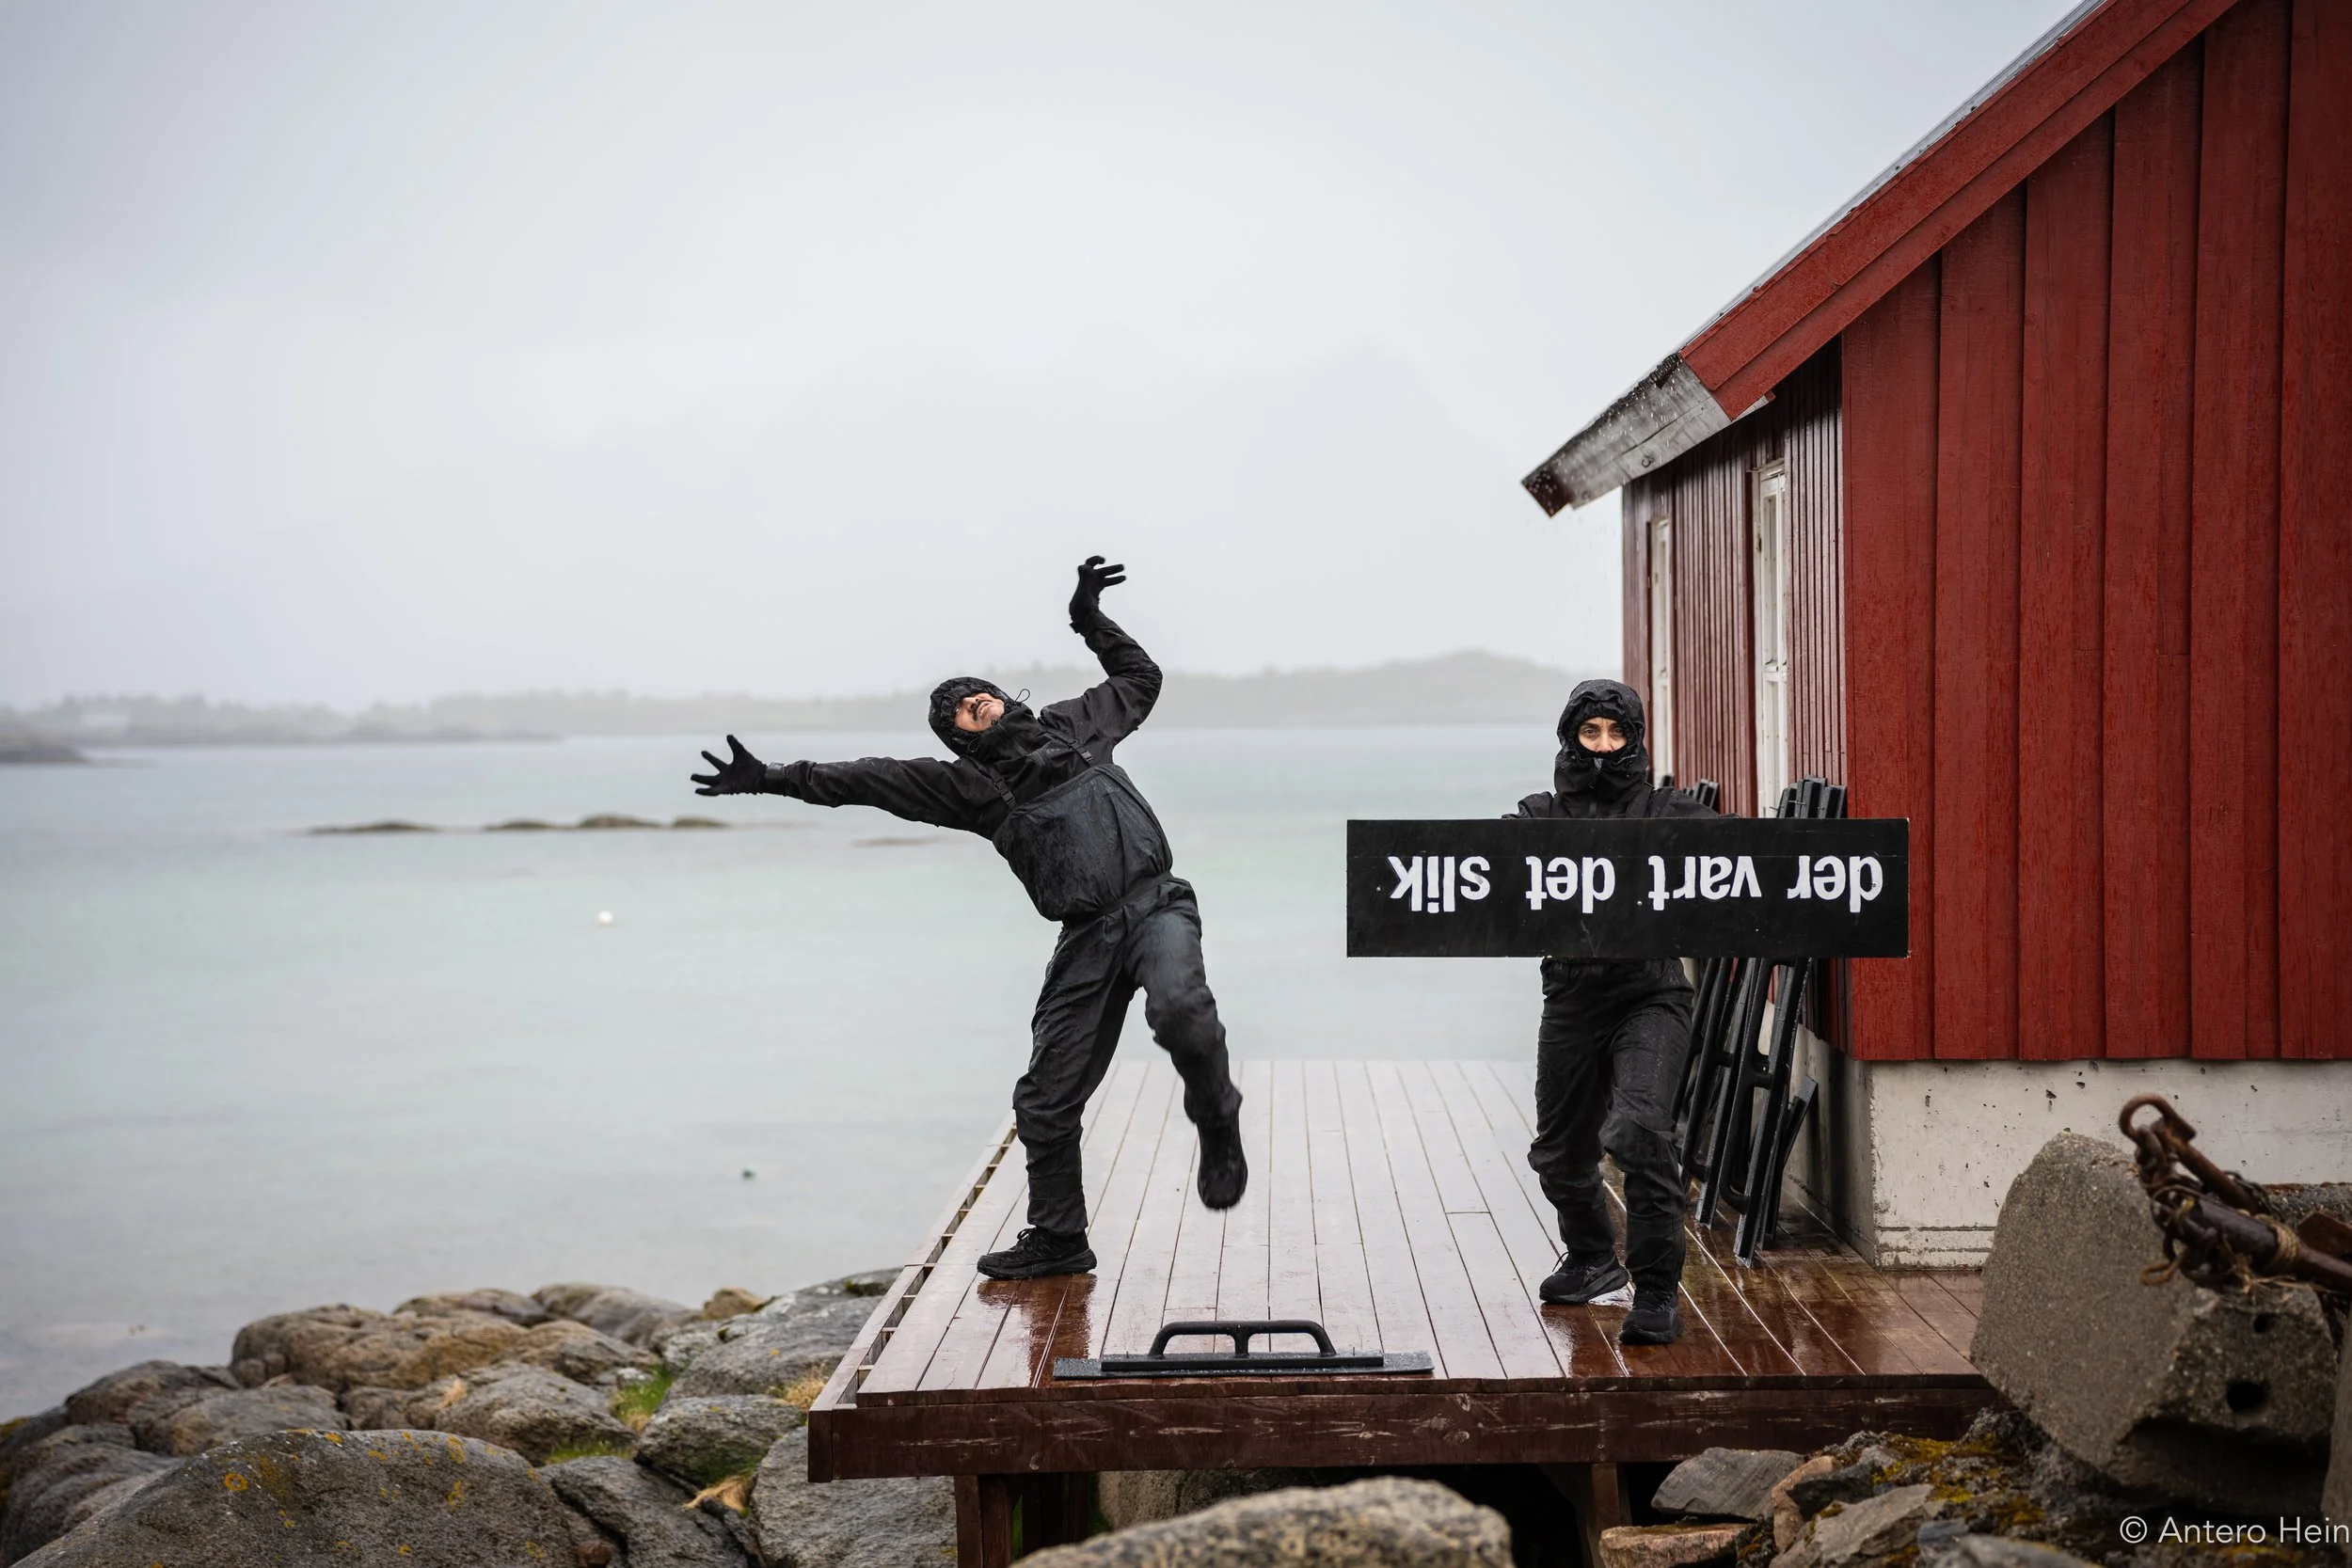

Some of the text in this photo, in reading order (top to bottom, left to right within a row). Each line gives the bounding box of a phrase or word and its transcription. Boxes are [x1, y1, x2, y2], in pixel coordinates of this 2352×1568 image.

[1387, 855, 1883, 914] der vart det slik
